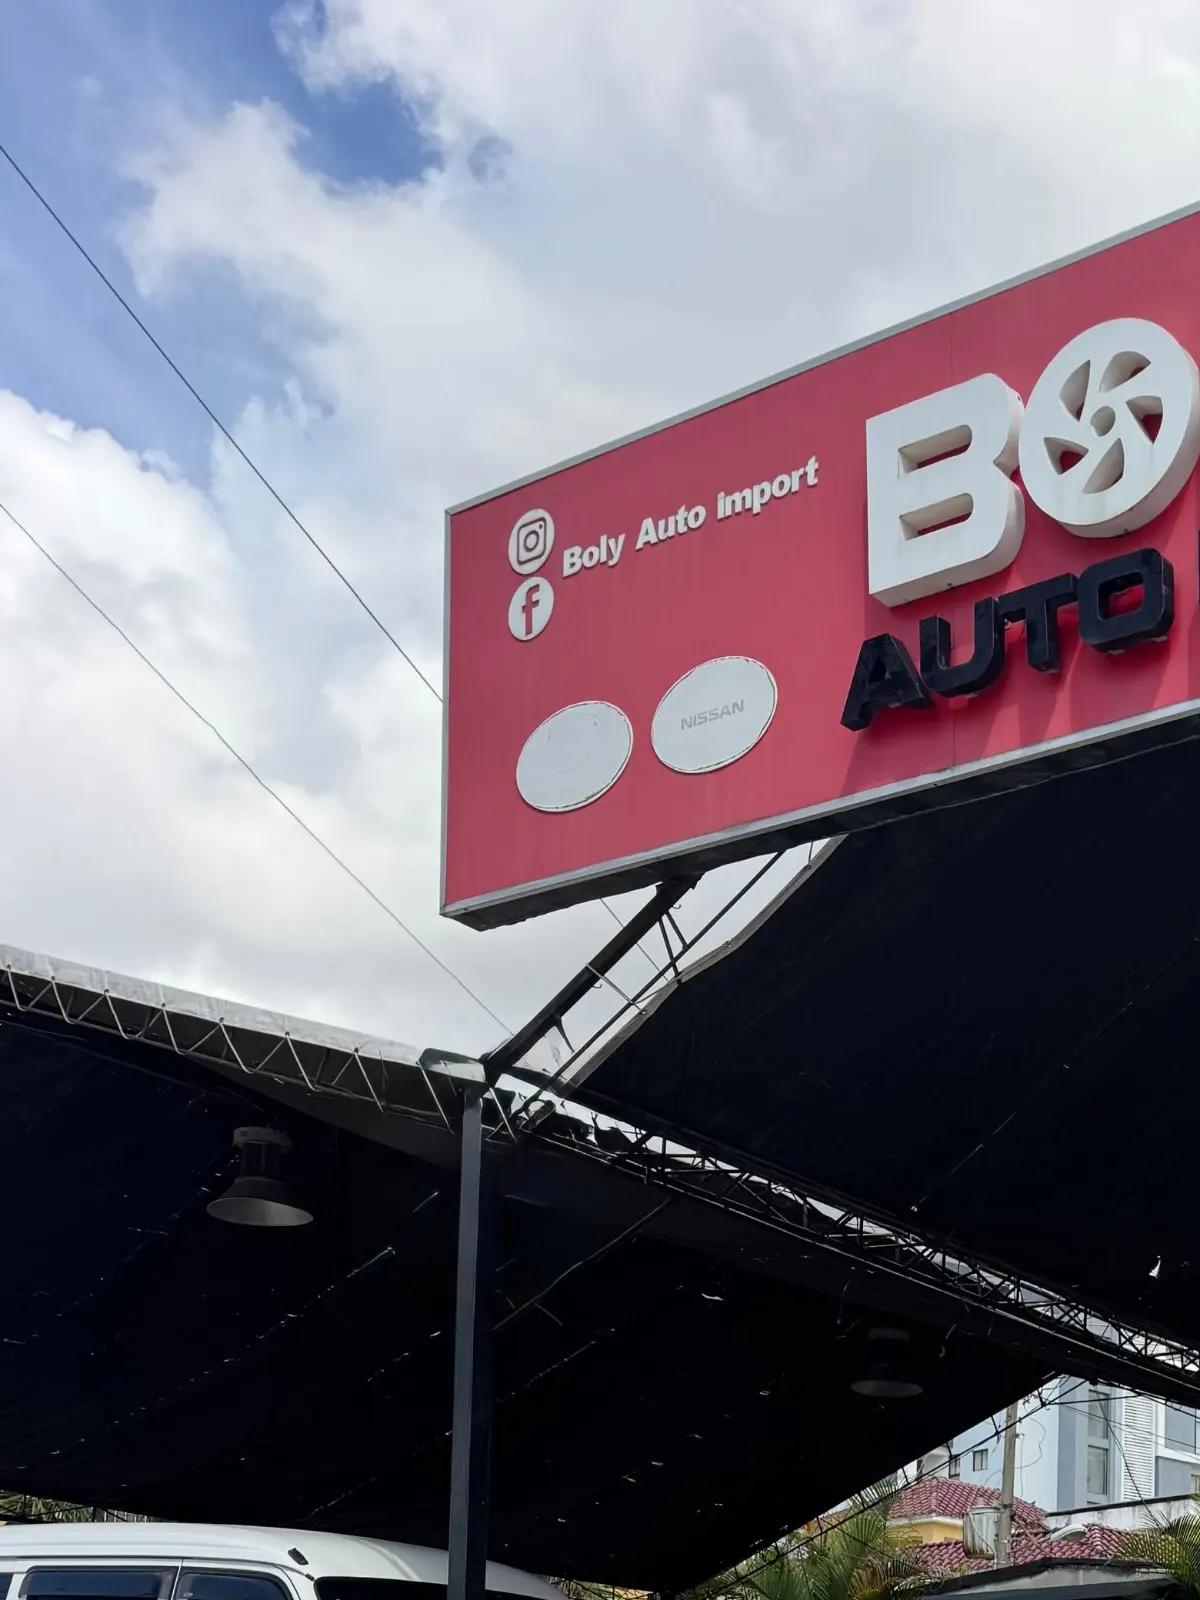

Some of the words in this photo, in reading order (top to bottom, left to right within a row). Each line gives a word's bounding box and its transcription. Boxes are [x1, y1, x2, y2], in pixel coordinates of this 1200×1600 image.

[562, 533, 626, 578] Boly
[635, 504, 707, 550] Auto
[840, 548, 1175, 731] AUTO
[680, 699, 745, 730] NISSAN
